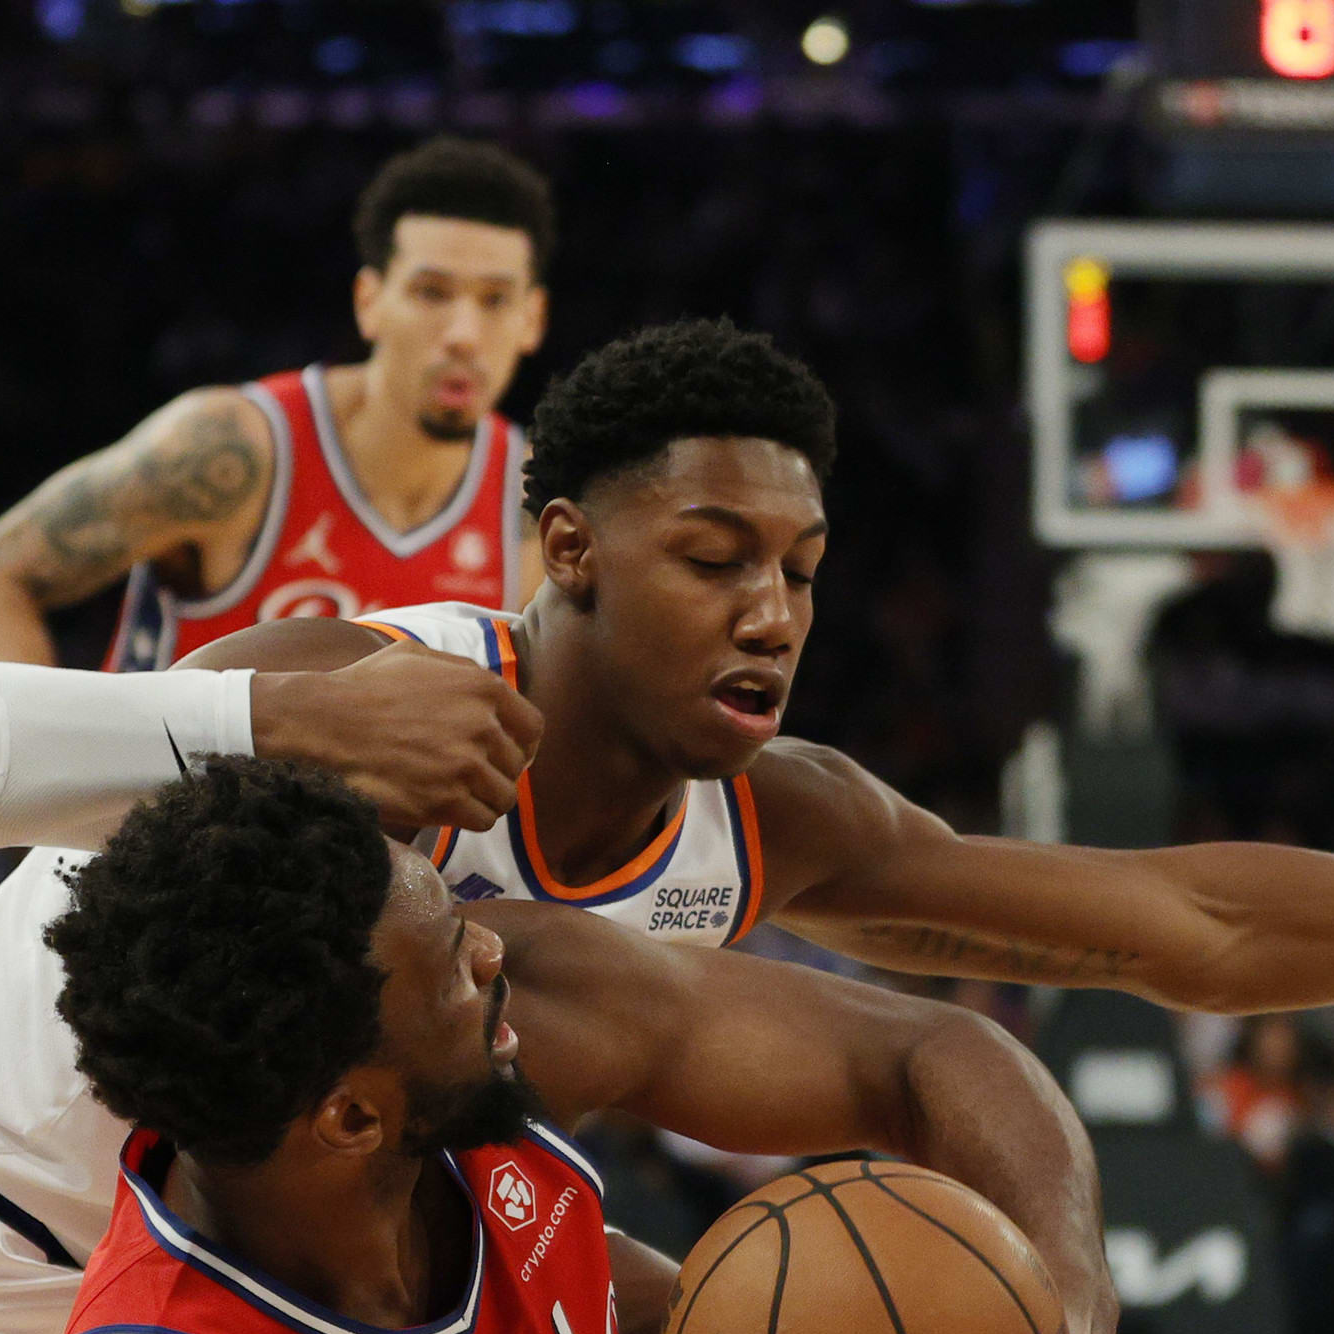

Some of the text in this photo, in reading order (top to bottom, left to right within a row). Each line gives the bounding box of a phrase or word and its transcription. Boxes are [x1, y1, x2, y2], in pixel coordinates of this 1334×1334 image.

[655, 887, 733, 908] SQUARE
[649, 910, 710, 931] SPACE
[520, 1186, 579, 1282] crypto.com
